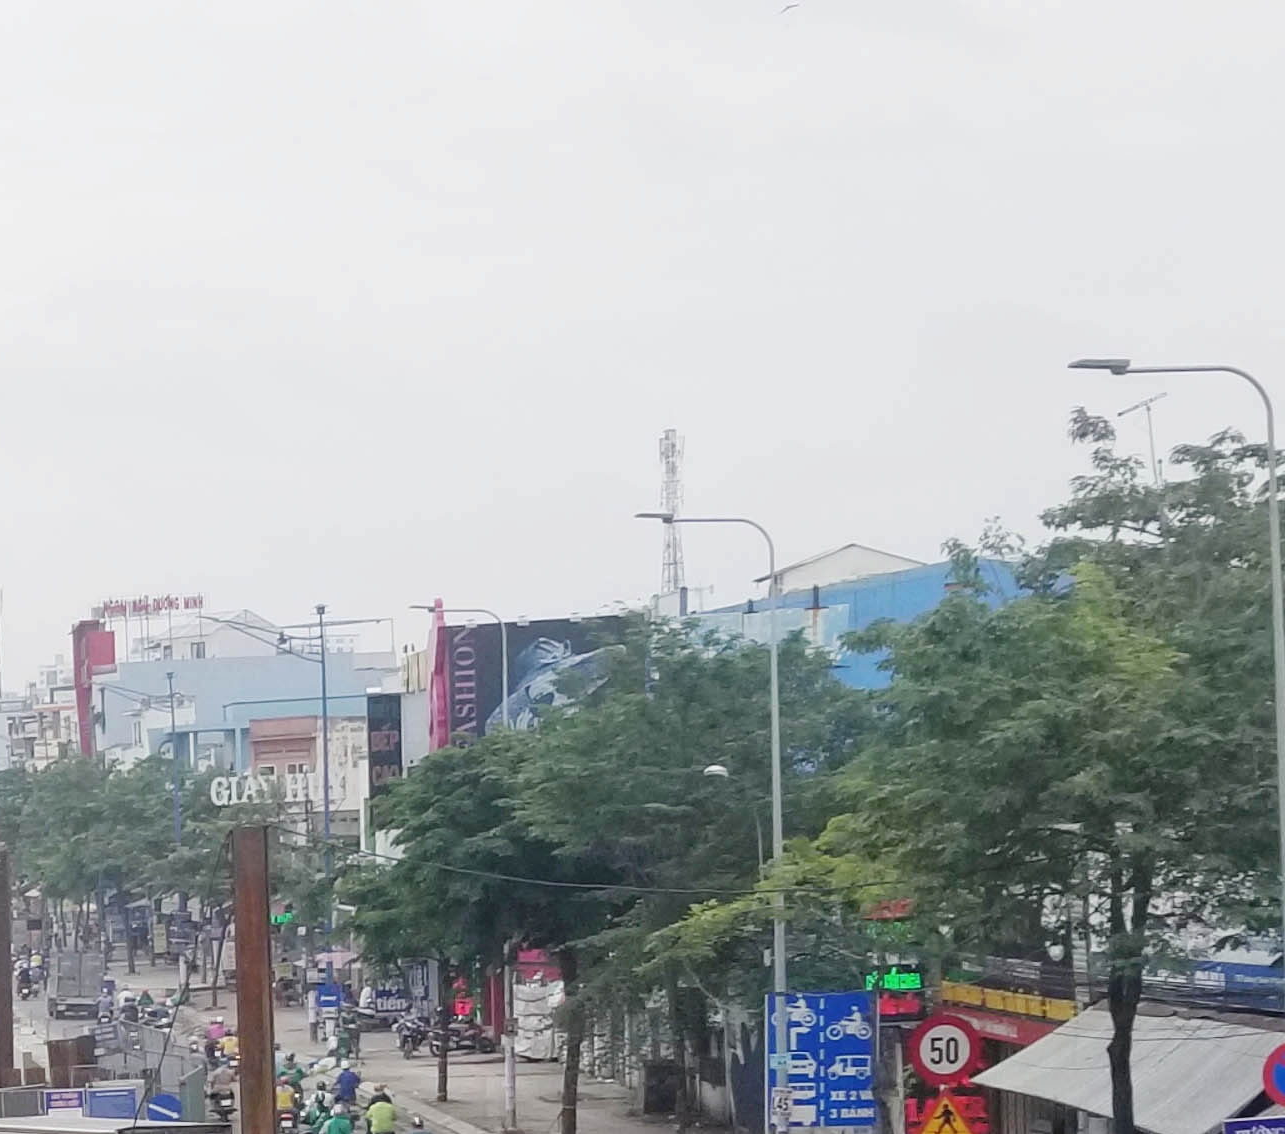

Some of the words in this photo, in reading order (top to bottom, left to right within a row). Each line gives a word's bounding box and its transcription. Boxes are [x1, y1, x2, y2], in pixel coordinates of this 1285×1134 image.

[930, 1037, 959, 1064] 50
[849, 1090, 858, 1101] 2
[829, 1108, 837, 1119] 3
